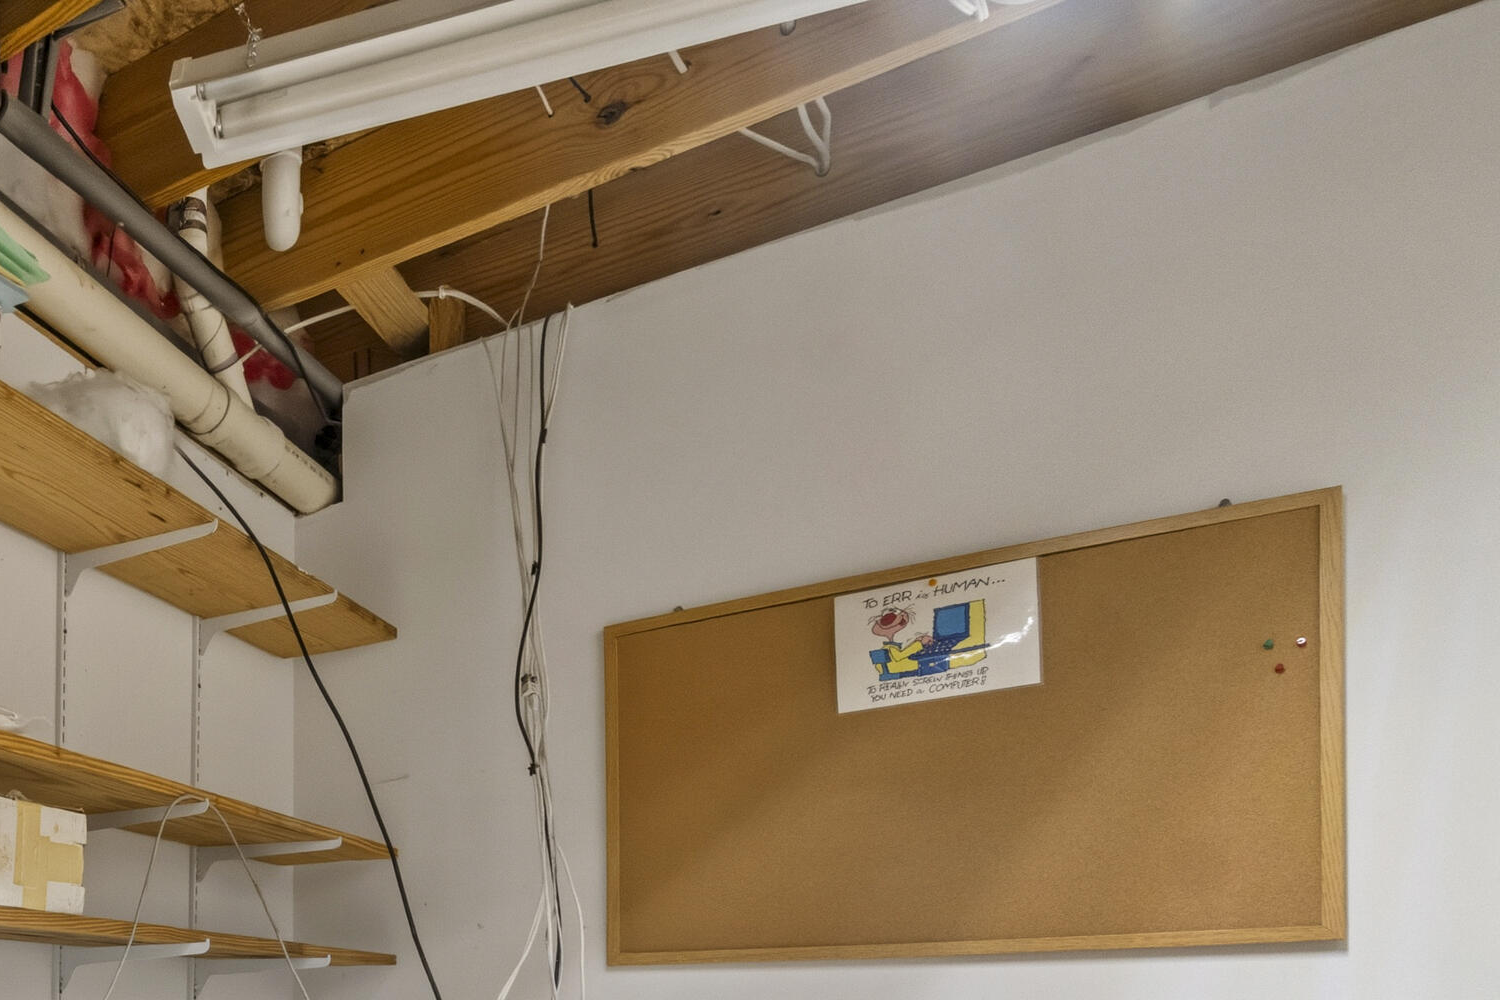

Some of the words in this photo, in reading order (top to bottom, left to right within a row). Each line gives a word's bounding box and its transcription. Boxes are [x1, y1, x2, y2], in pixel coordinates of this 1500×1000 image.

[863, 597, 879, 609] TO
[883, 590, 913, 607] ERR
[866, 685, 877, 695] TO
[976, 666, 989, 676] UP
[870, 693, 887, 703] YOU
[889, 688, 914, 699] NEED
